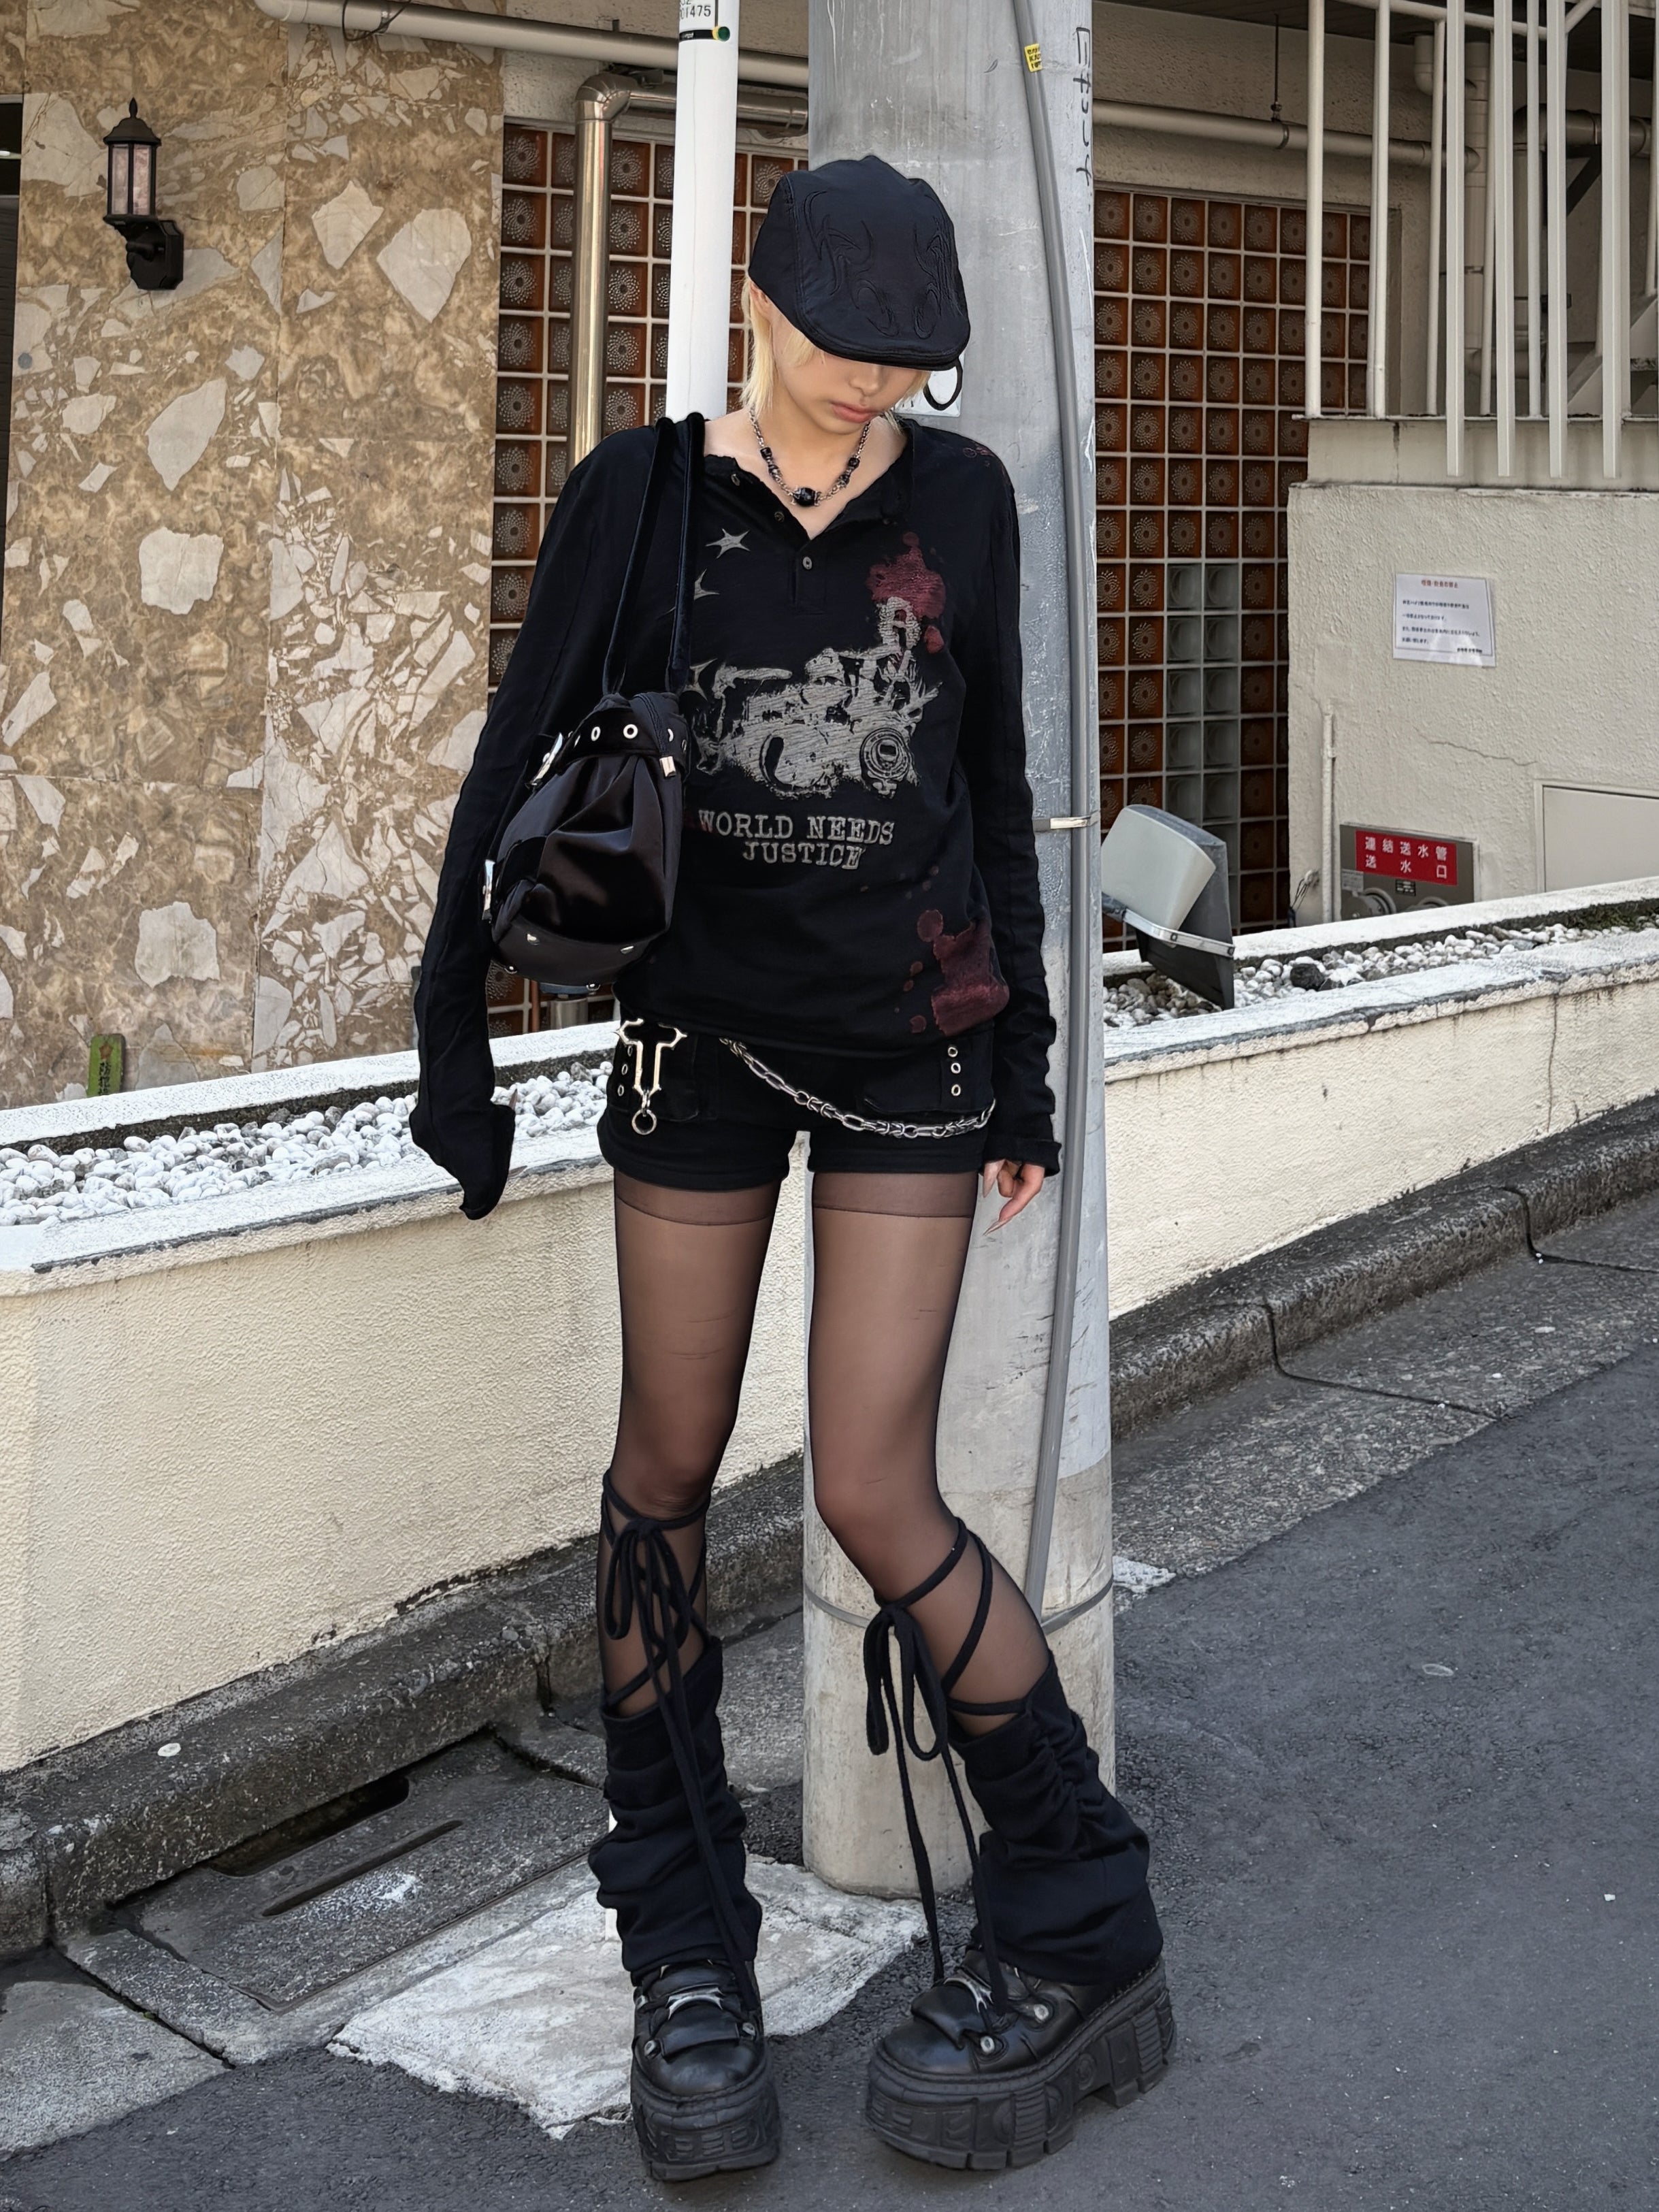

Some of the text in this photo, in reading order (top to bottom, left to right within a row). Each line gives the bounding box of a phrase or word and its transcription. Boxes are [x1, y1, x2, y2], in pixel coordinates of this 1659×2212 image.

[698, 809, 896, 845] WORLD NEEDS
[742, 841, 865, 870] JUSTICE
[1364, 836, 1447, 862] 連結送水管
[1365, 854, 1447, 879] 送水口
